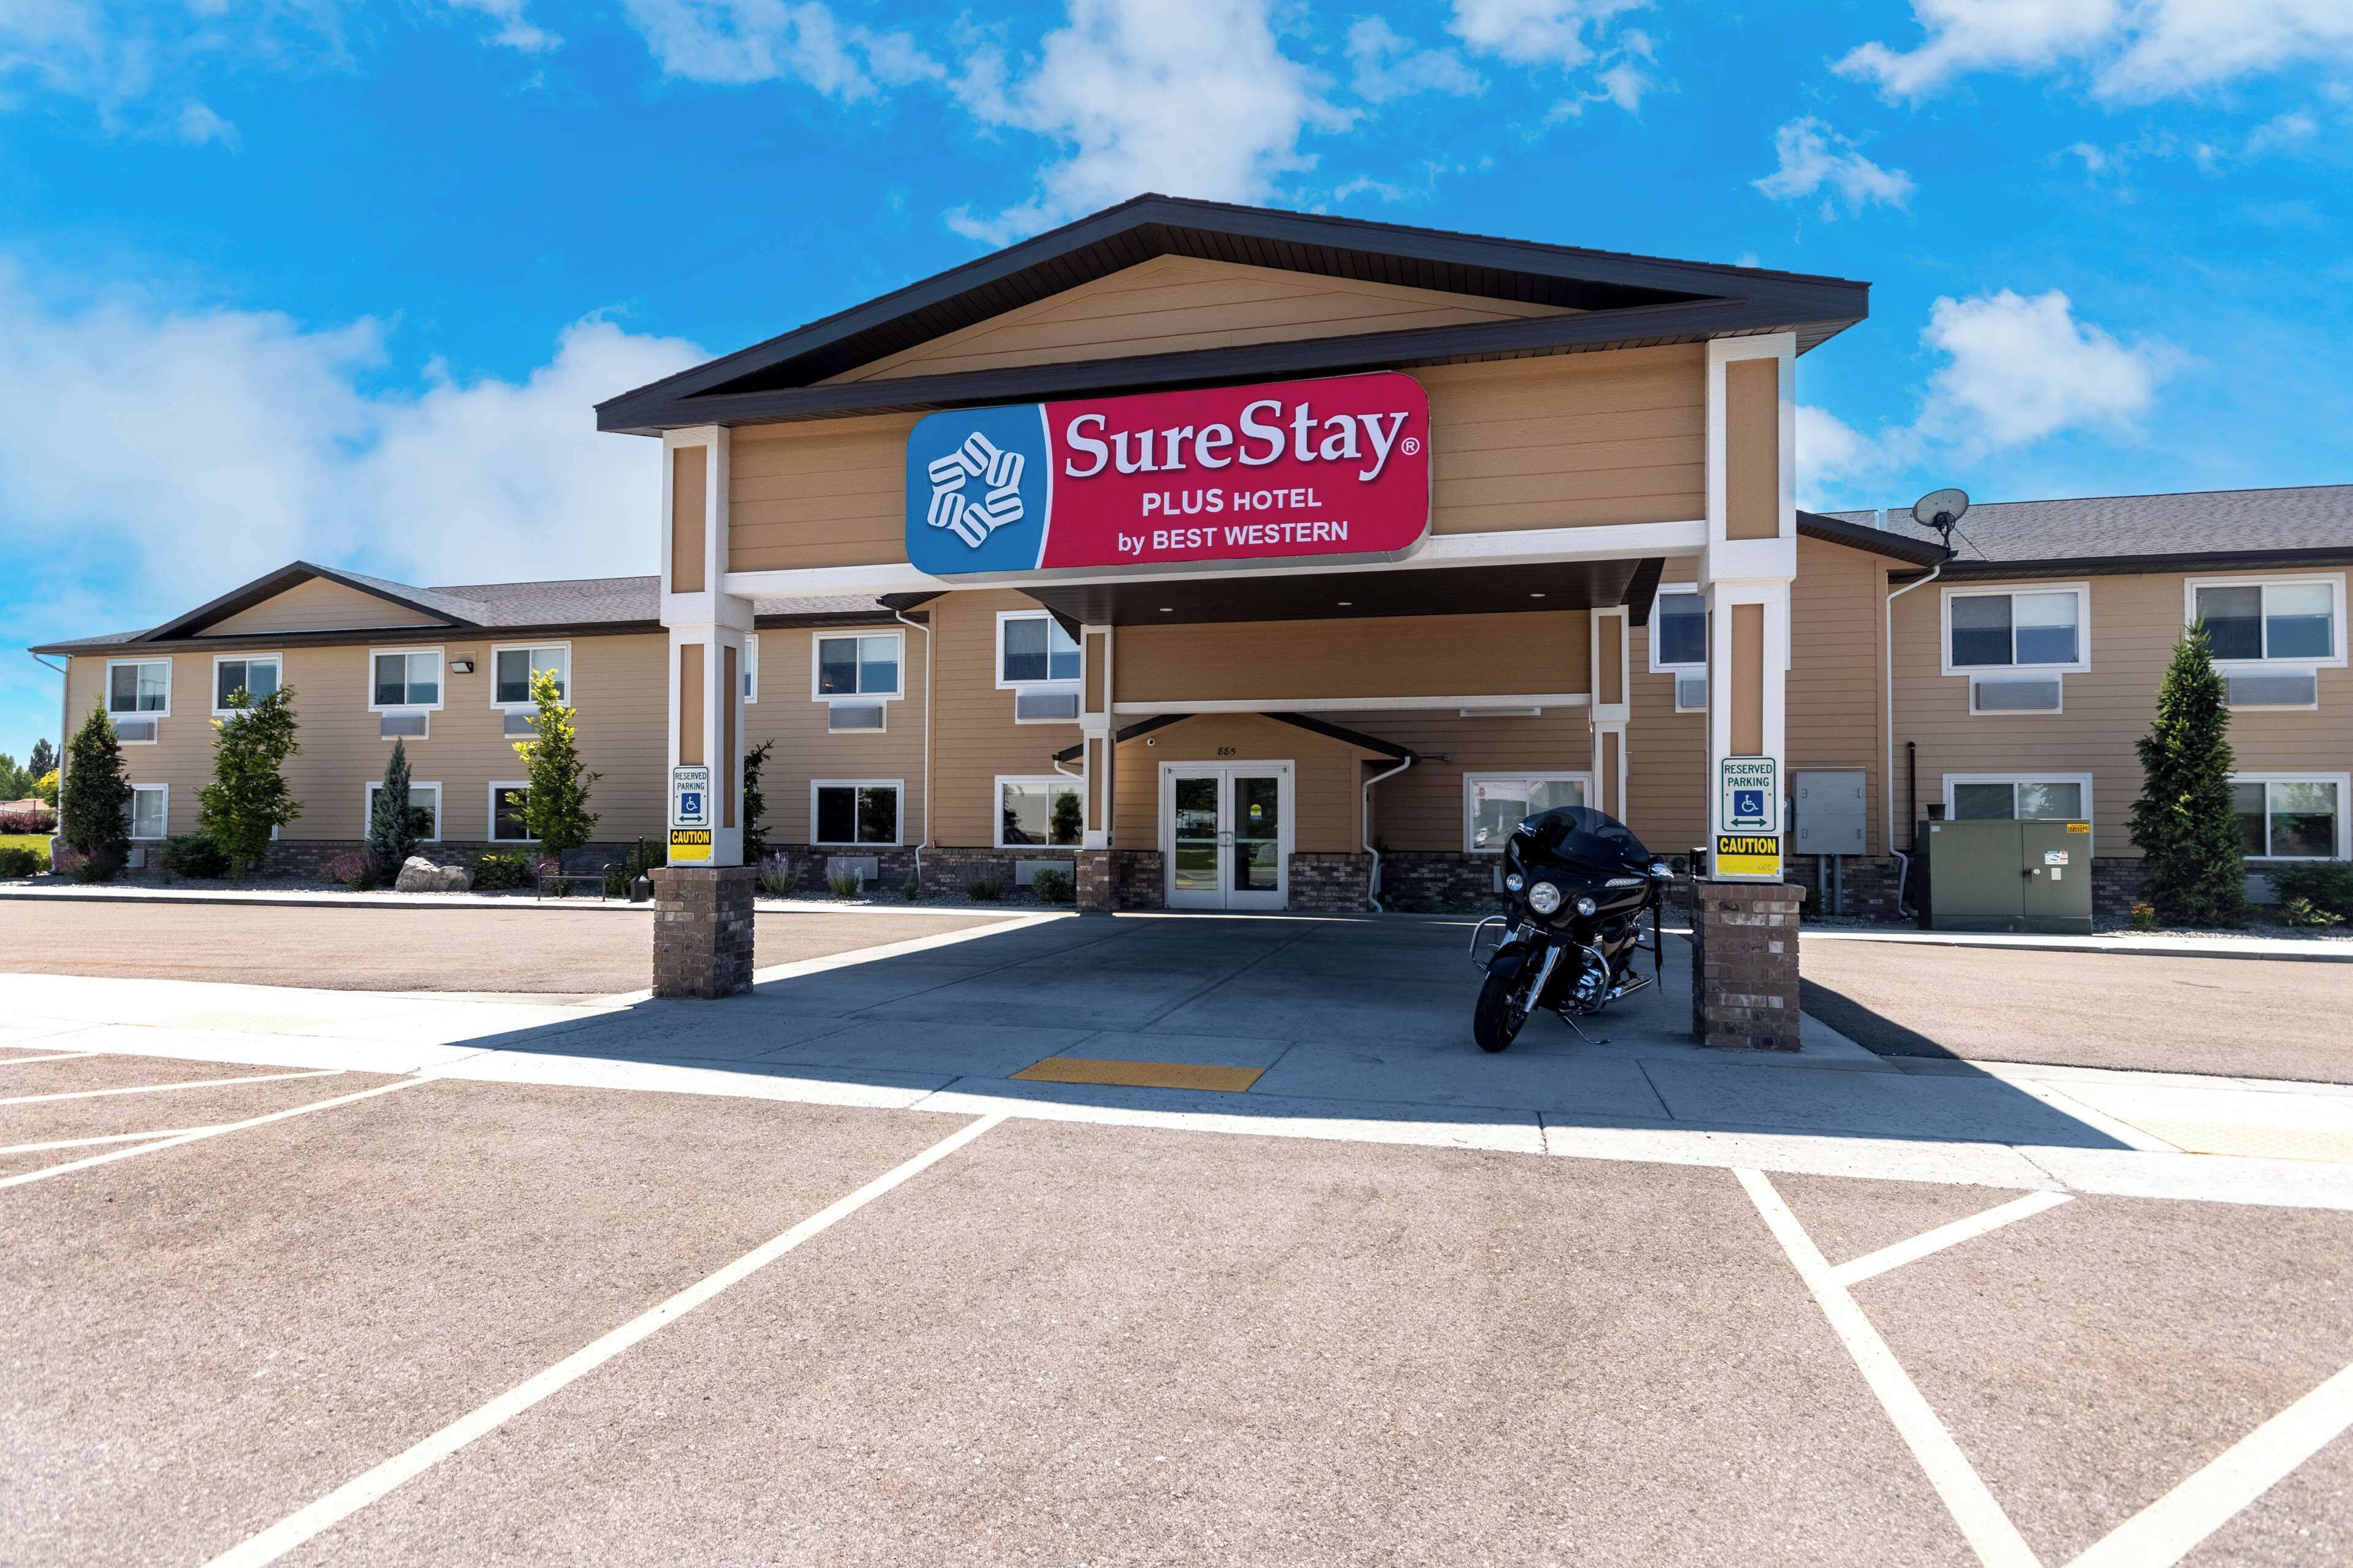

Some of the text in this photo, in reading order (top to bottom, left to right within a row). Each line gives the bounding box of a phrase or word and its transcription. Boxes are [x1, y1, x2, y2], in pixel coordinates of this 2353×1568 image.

[1142, 488, 1322, 516] PLUS HOTEL
[1118, 521, 1348, 555] by BEST WESTERN
[1218, 747, 1236, 756] 885
[1724, 764, 1773, 774] RESERVED
[1728, 777, 1770, 787] PARKING
[672, 831, 710, 844] CAUTION
[1720, 837, 1776, 854] CAUTION
